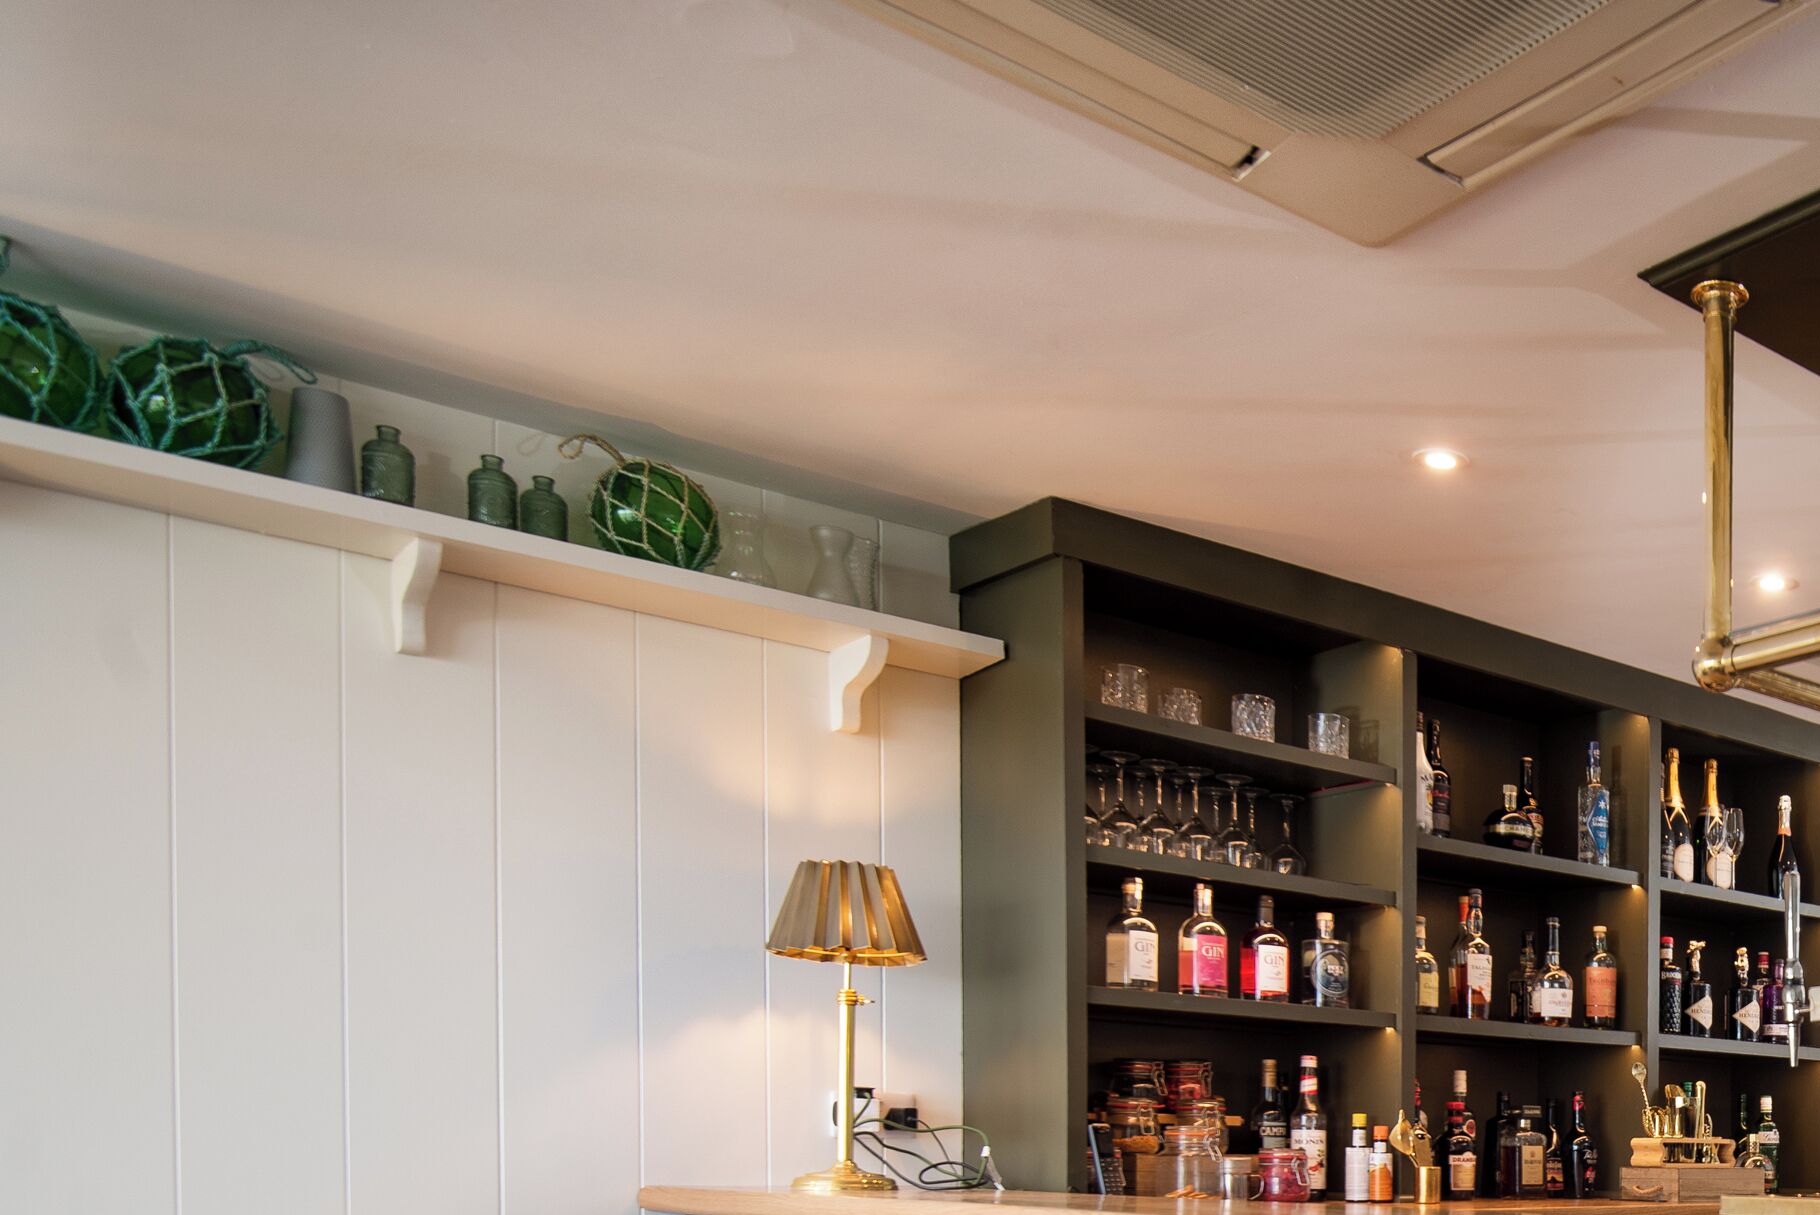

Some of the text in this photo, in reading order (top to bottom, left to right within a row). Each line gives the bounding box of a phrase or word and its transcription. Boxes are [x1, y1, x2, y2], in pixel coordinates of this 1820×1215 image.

[1134, 941, 1155, 953] GIN
[1201, 945, 1225, 958] GIN
[1264, 953, 1285, 966] GIN
